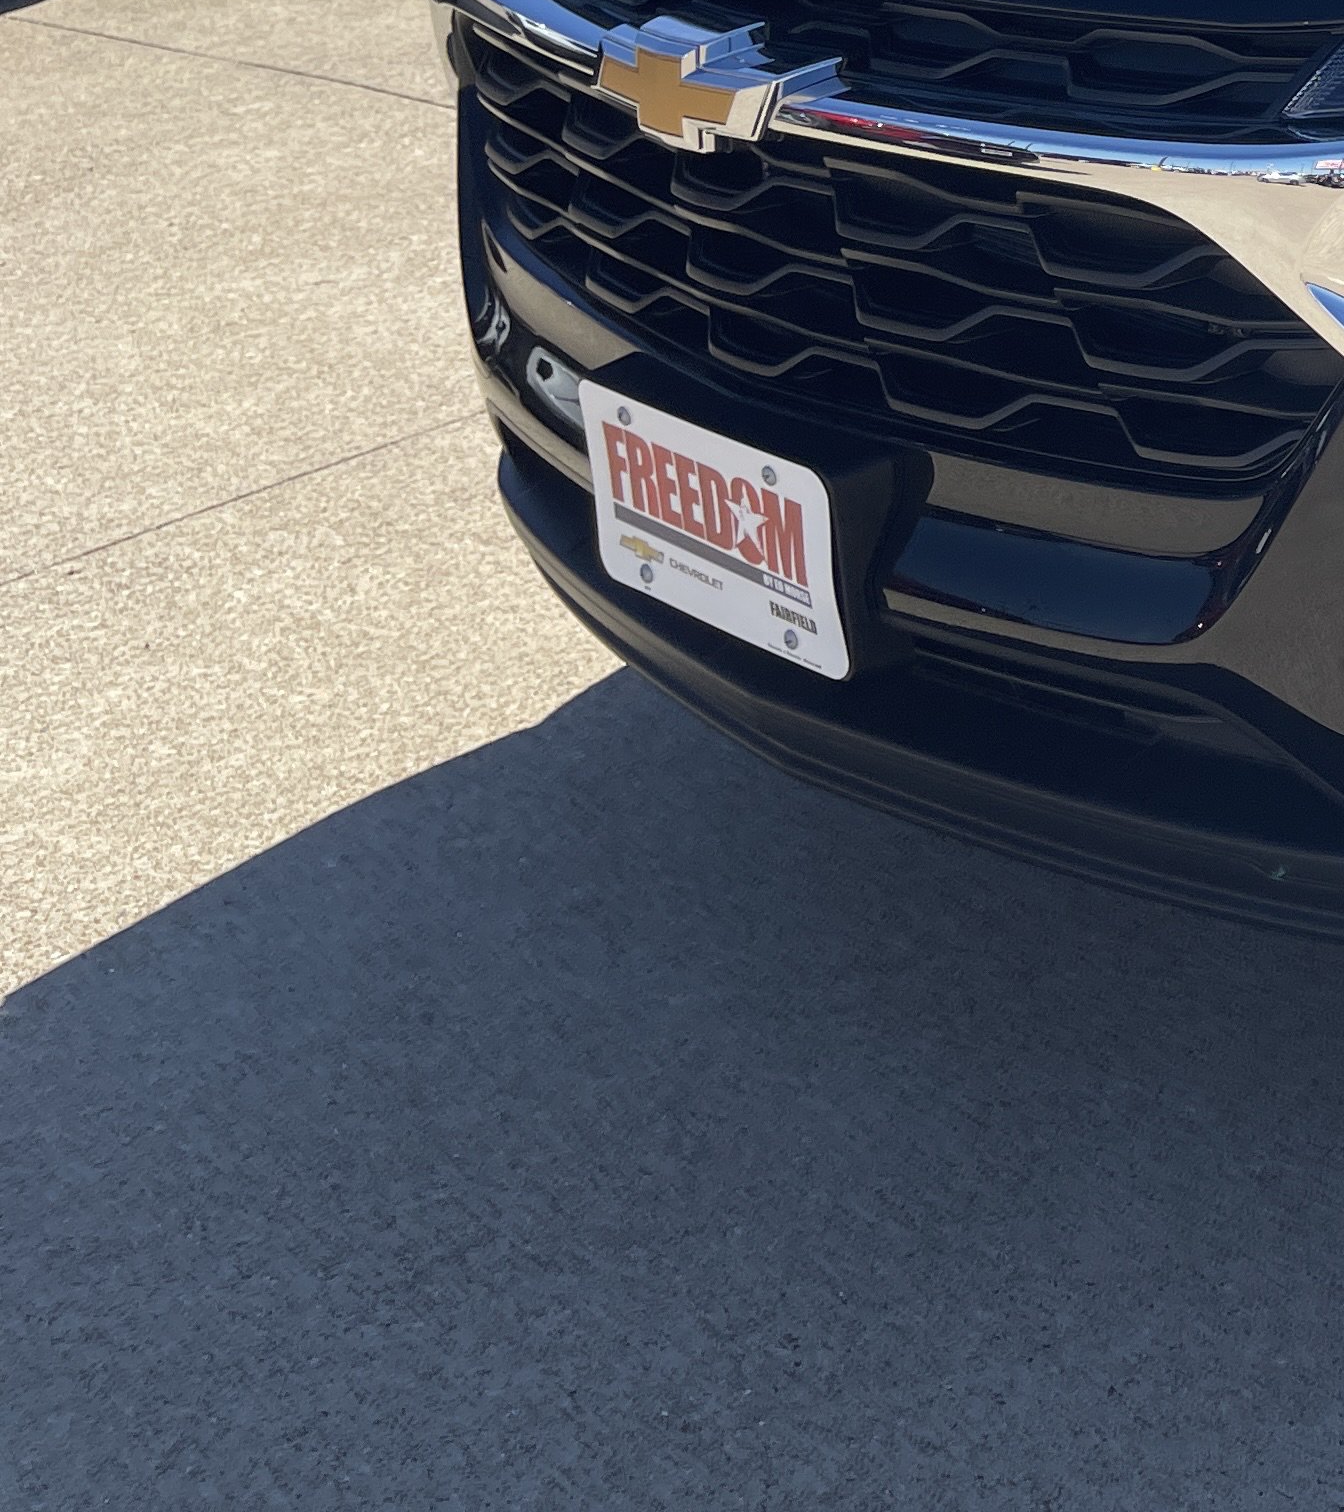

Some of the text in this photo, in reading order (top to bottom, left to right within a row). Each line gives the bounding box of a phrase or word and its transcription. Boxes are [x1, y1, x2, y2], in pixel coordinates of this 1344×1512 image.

[602, 421, 809, 588] FREEDOM
[669, 557, 723, 590] CHEVROLET
[769, 600, 818, 636] FAIRFIELD
